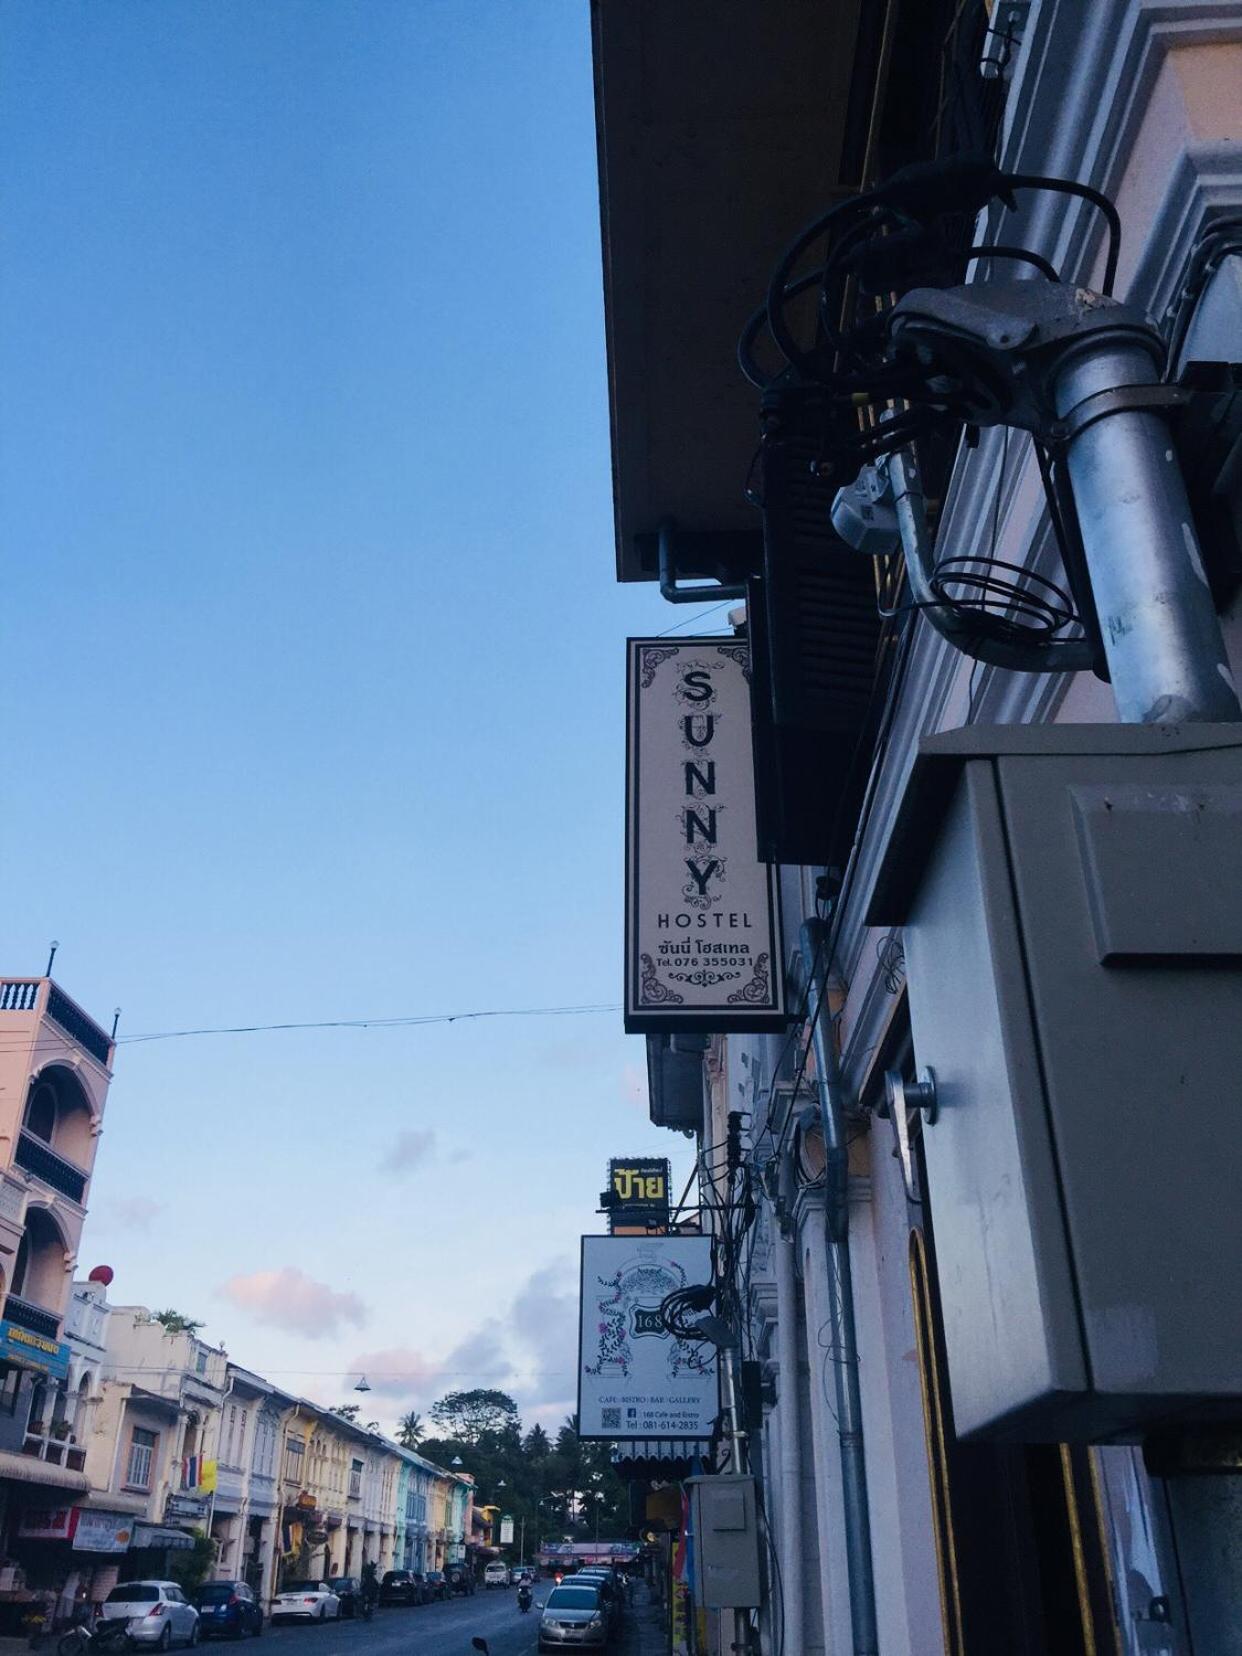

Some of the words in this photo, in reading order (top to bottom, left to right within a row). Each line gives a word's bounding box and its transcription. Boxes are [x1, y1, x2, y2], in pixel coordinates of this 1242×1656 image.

[684, 671, 719, 895] SUNNY
[658, 913, 752, 928] HOSTEL
[702, 957, 753, 967] 355031
[637, 1314, 663, 1328] 168
